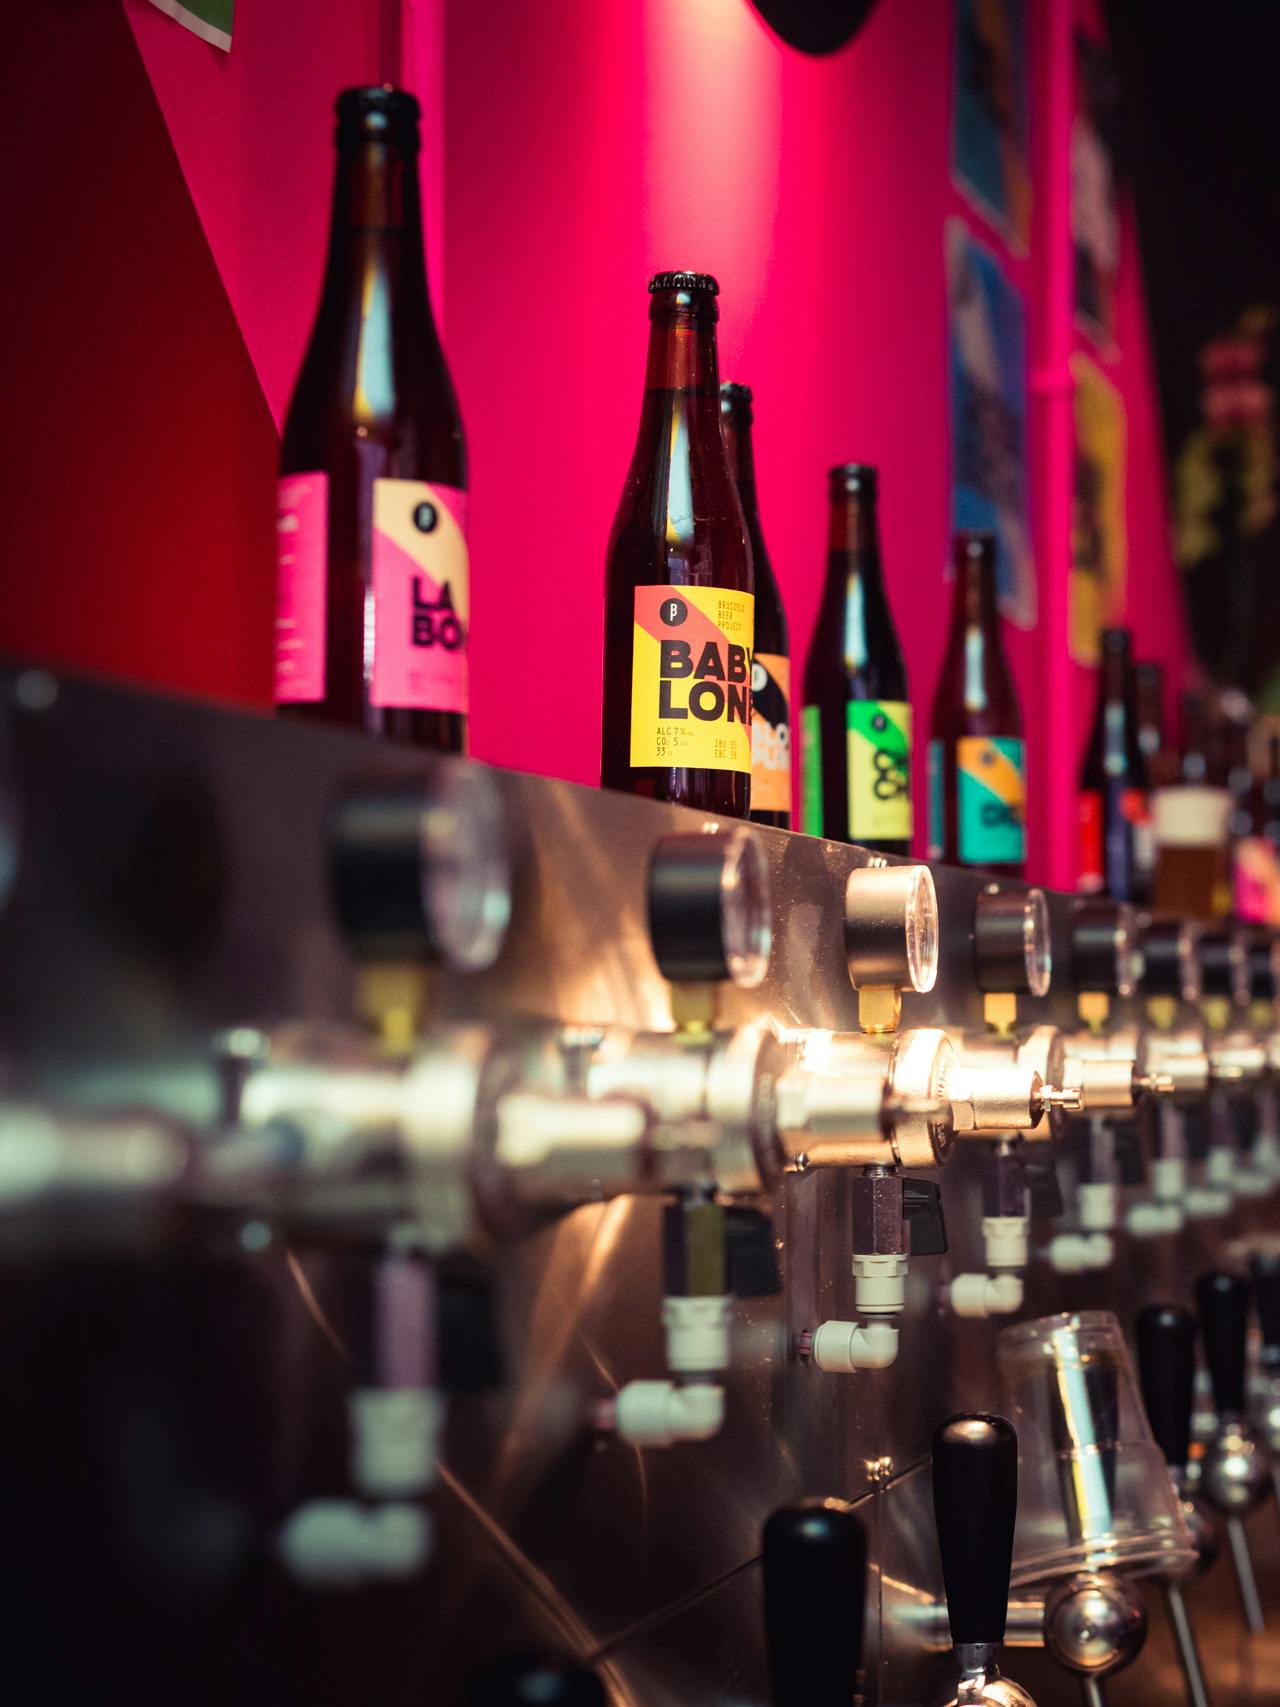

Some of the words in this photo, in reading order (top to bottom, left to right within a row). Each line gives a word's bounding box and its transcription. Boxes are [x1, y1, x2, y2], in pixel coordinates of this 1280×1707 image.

[412, 576, 455, 610] LA
[718, 610, 732, 620] BEER
[656, 727, 672, 736] ALC
[656, 747, 666, 757] 33
